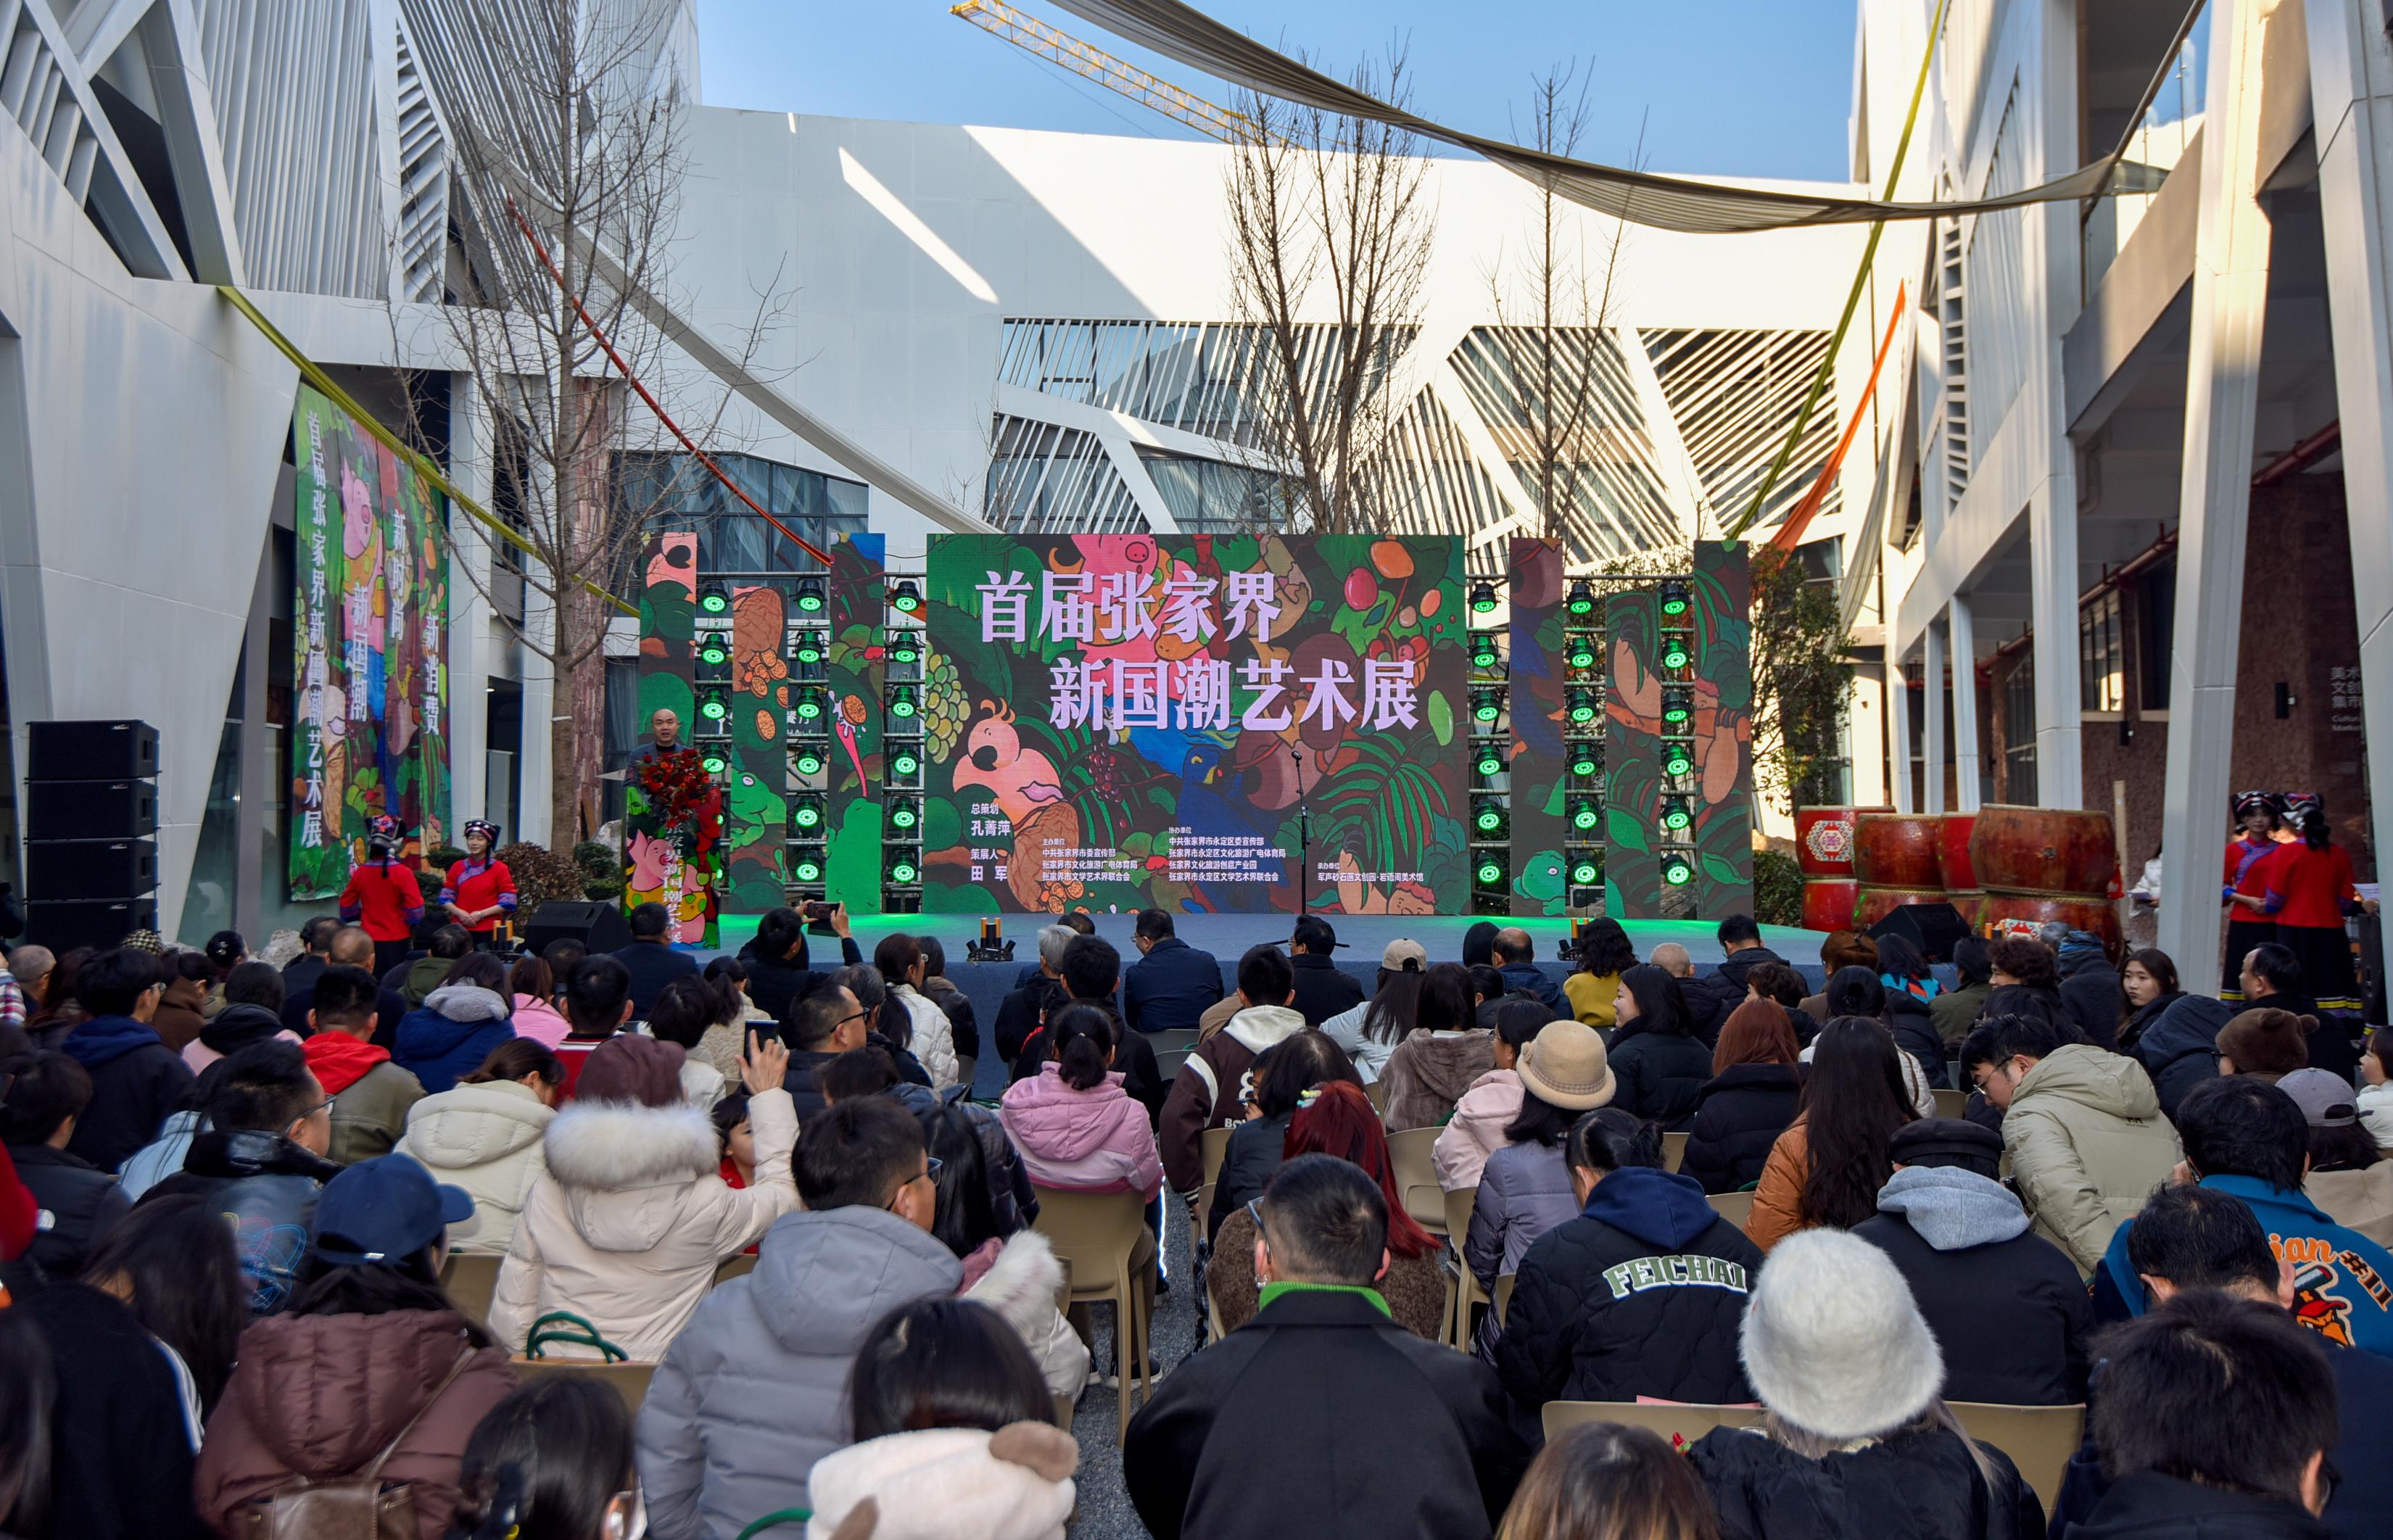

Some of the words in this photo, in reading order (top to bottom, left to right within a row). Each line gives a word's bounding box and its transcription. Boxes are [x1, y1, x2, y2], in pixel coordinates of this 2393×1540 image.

[391, 509, 406, 641] 新时尚
[975, 570, 1281, 643] 首届张家界
[351, 581, 368, 722] 新国潮
[425, 611, 439, 735] 新消费
[1049, 657, 1419, 731] 新国潮艺术展
[971, 803, 999, 814] 总策划
[971, 820, 1010, 836] 孔菁萍
[1169, 837, 1264, 846] 中共张家界市永定区委宣传部
[970, 848, 999, 860] 策展人
[1042, 848, 1116, 858] 中共张家界市委宣传部
[1169, 848, 1286, 858] 张家界市永定区文化旅游广电体育局
[1042, 860, 1138, 869] 张家界市文化旅游广电体育局
[1169, 860, 1257, 869] 张家界文化旅游创意产业园
[1042, 872, 1131, 882] 张家界市文学艺术界联合会
[1169, 872, 1279, 882] 张家界市永定区文学艺术界联合会
[1602, 1254, 1748, 1300] FEICHAI
